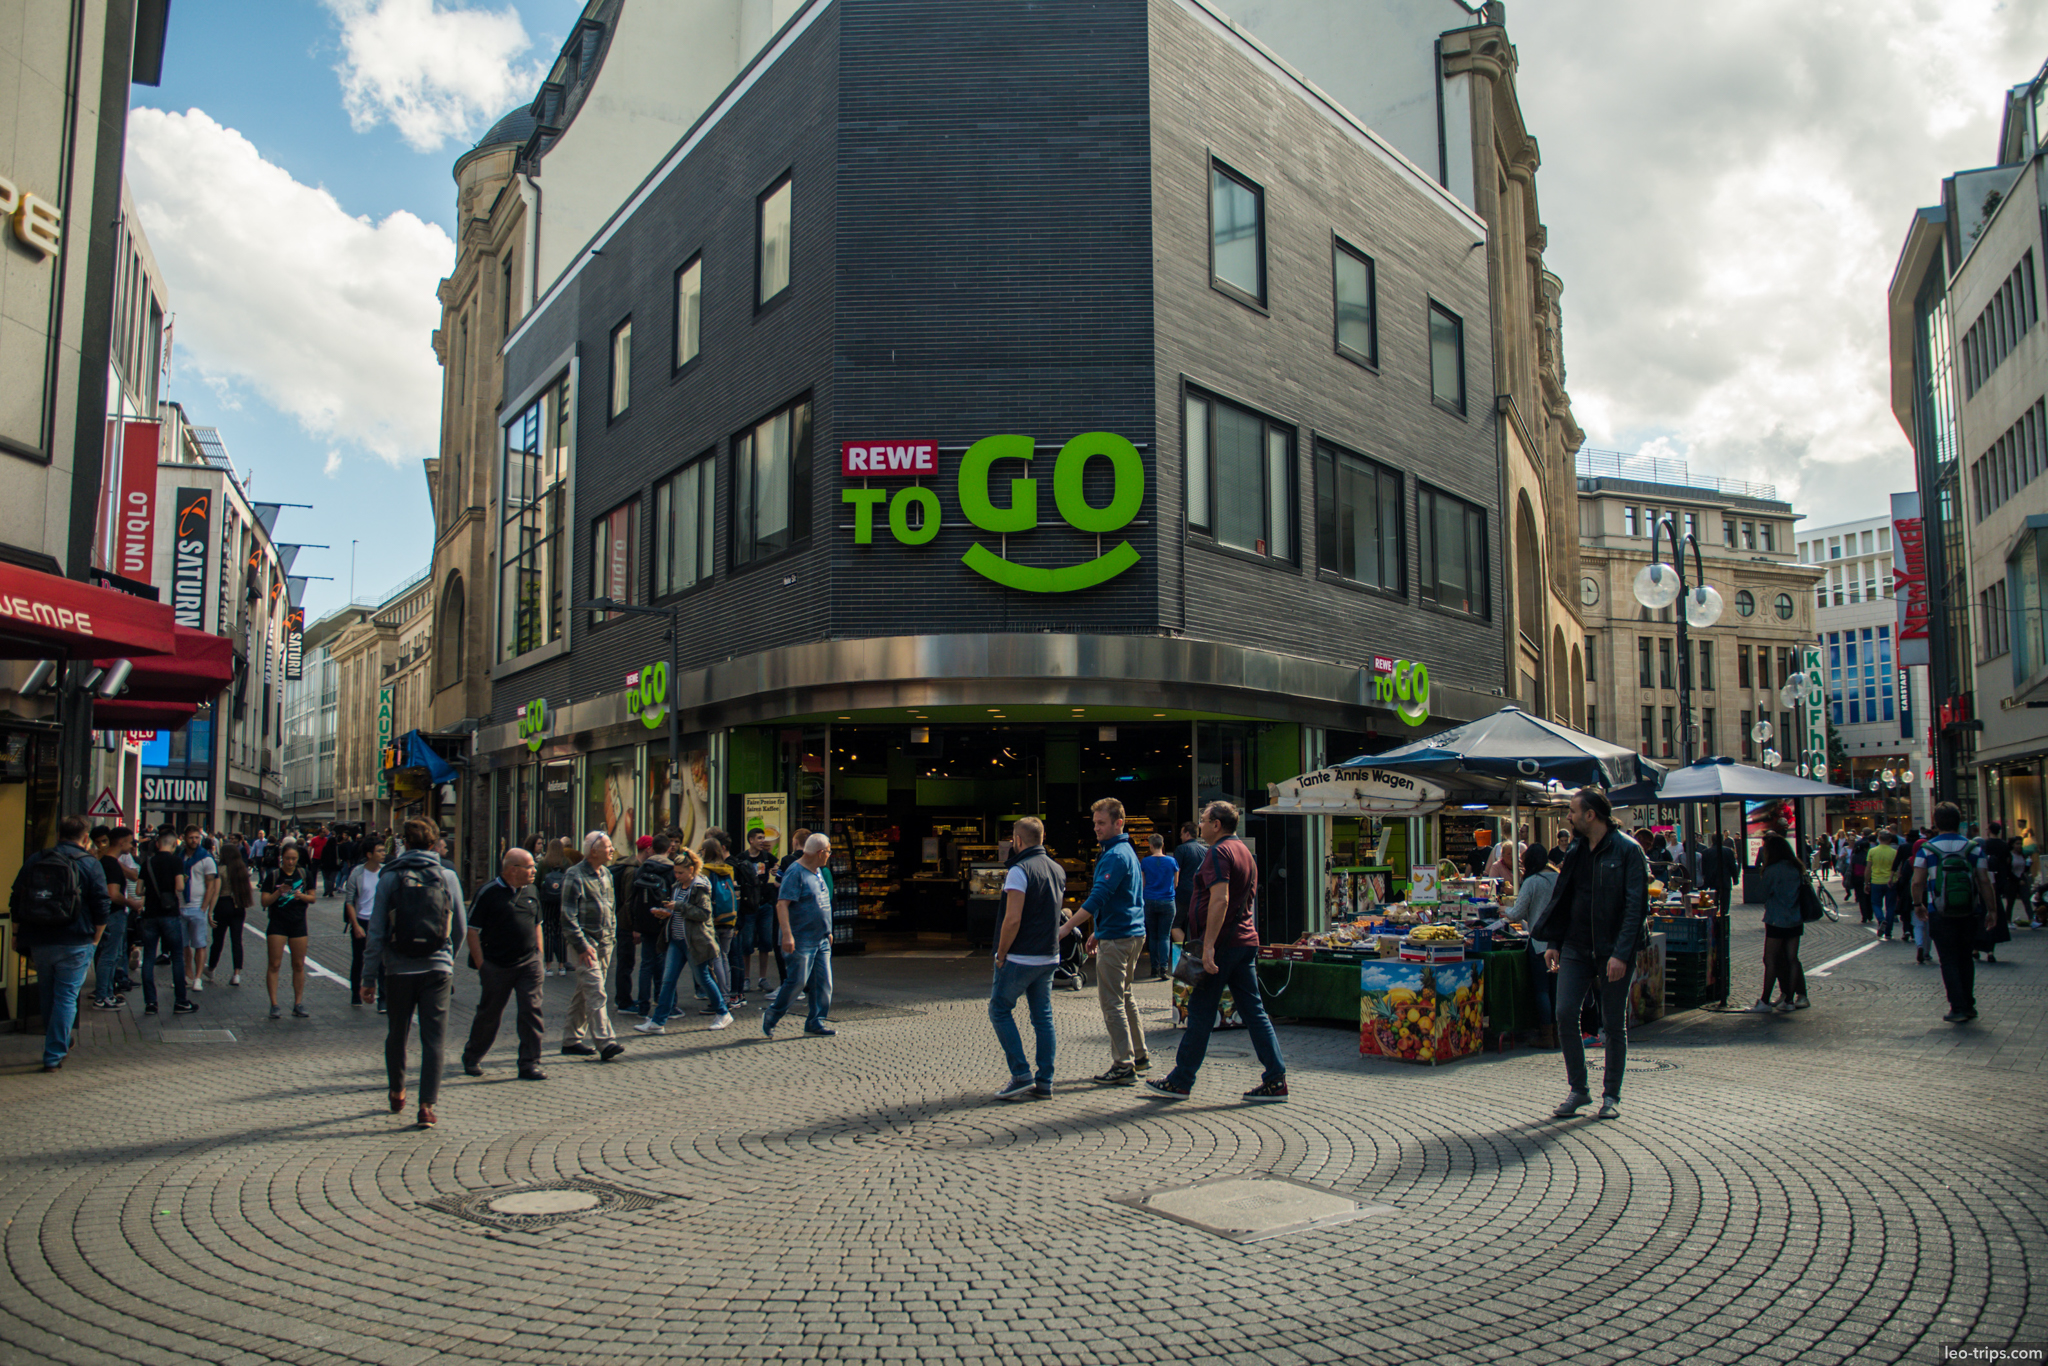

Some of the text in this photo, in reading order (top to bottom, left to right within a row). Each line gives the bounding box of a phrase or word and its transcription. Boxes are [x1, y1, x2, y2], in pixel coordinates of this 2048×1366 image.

[849, 446, 932, 470] REWE
[842, 431, 1145, 545] TO GO
[124, 491, 150, 571] UNIQLO
[174, 539, 205, 627] SATURN
[287, 632, 303, 677] SATURN
[1375, 657, 1392, 671] REWE
[641, 661, 667, 706] GO
[1374, 659, 1429, 704] TO GO
[1899, 669, 1909, 712] KARSTADT
[527, 698, 544, 734] GO
[144, 777, 208, 801] SATURN
[1296, 771, 1331, 788] Tante
[1372, 769, 1414, 790] Wagen
[1850, 801, 1883, 811] ESPRIT
